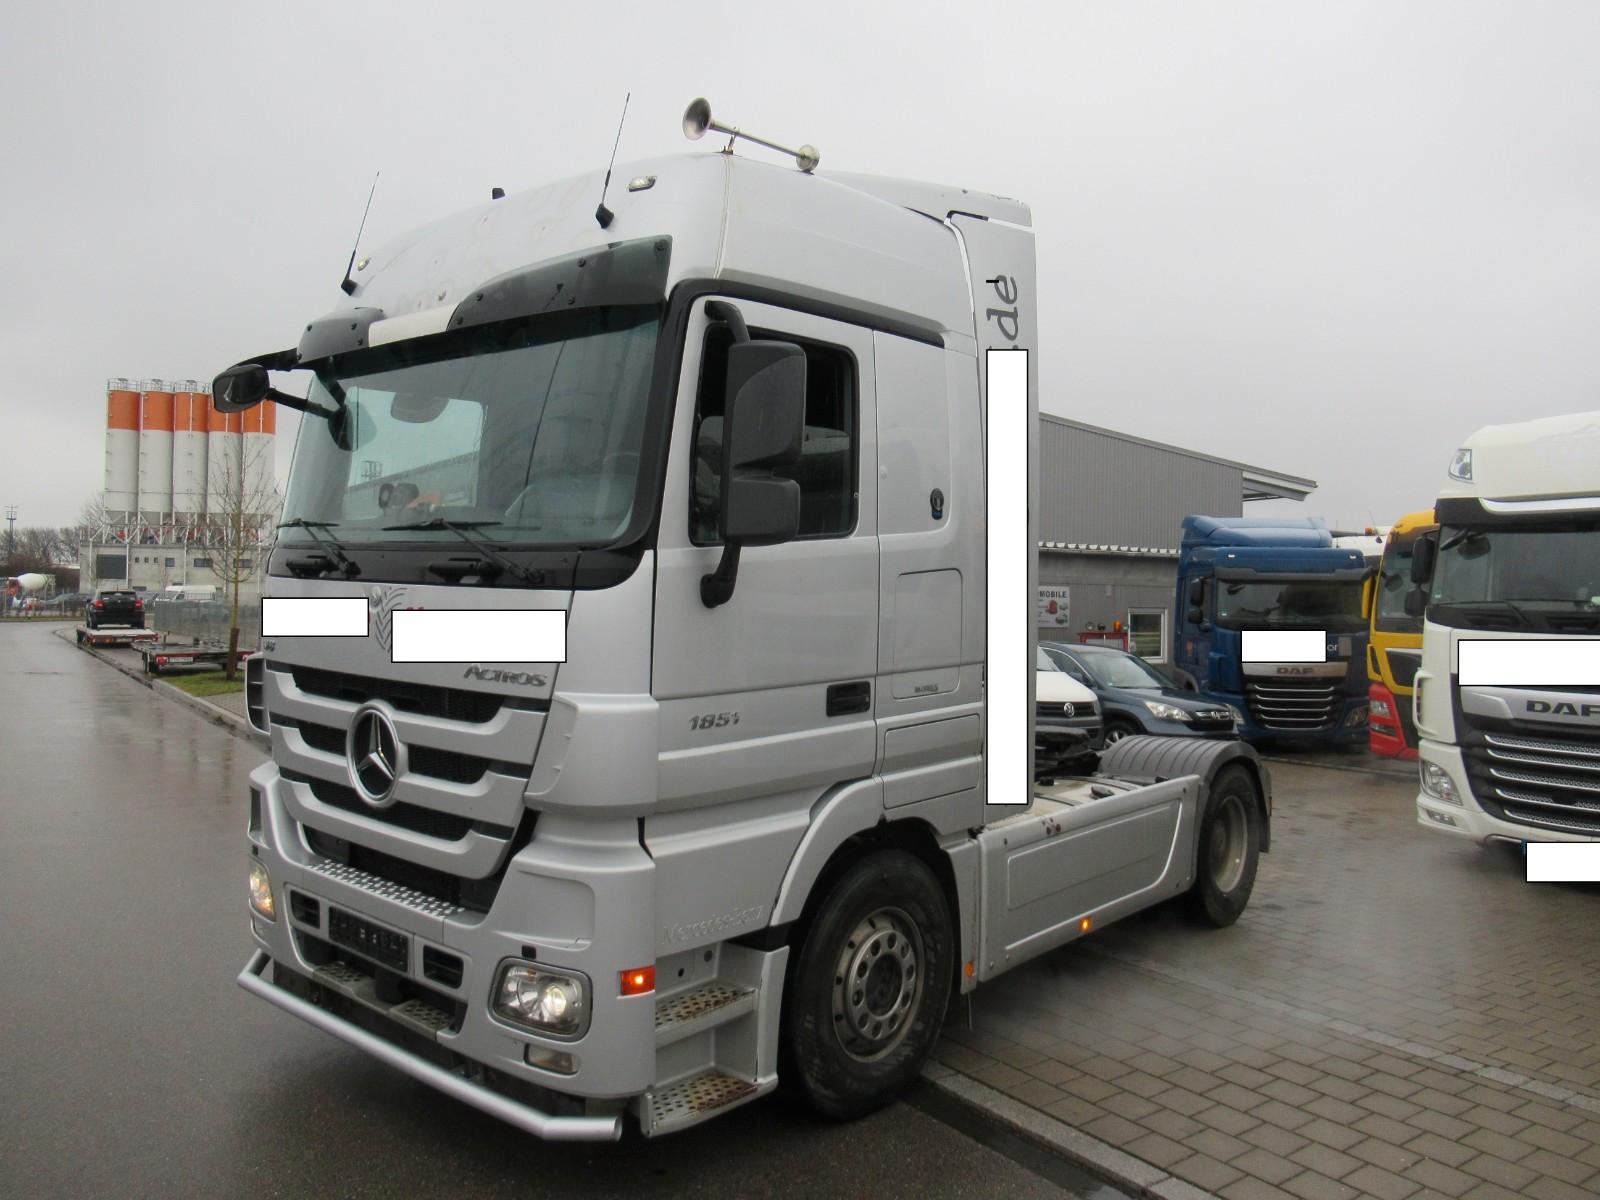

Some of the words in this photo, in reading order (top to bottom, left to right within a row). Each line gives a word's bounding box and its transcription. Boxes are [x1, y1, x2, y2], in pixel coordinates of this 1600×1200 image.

[1276, 667, 1314, 675] DAF
[1526, 700, 1600, 717] DAF
[689, 711, 740, 730] 1851
